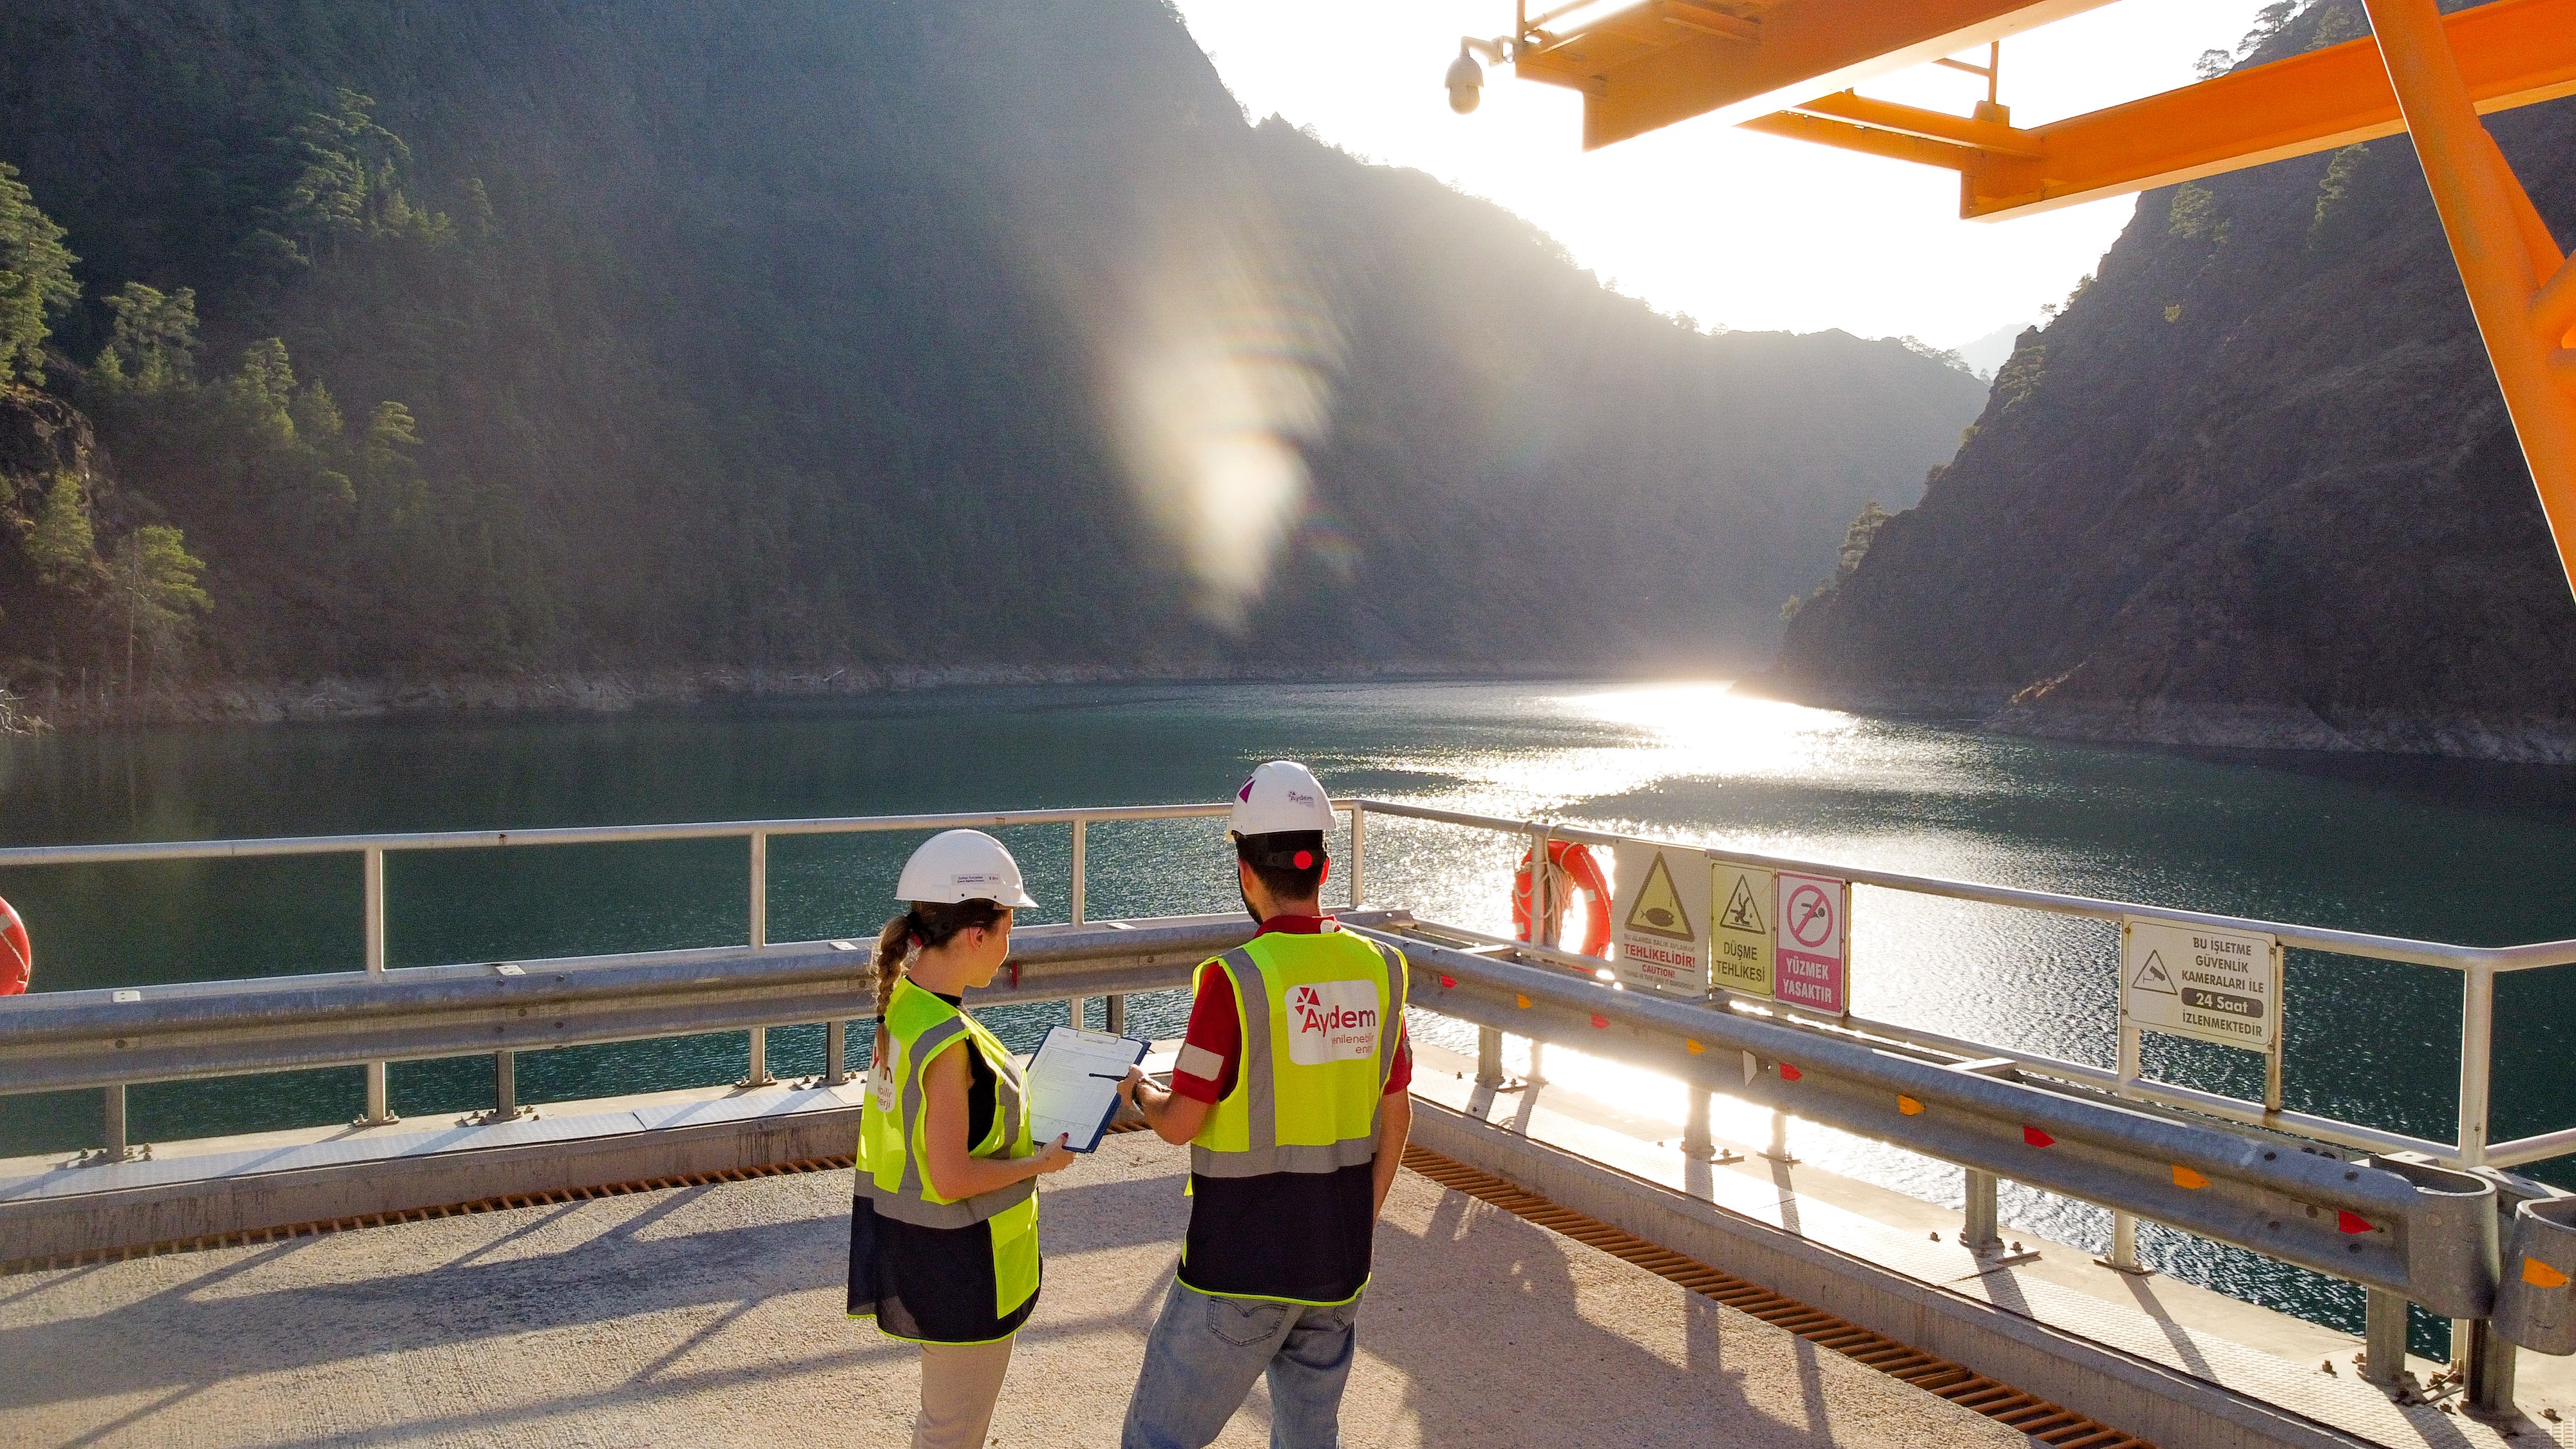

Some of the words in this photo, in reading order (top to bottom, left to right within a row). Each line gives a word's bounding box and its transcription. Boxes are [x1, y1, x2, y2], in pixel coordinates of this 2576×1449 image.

[1624, 943, 1695, 968] TEHLİKELİDİR!
[1724, 940, 1757, 960] DÜŞME
[2193, 937, 2207, 949] BU
[2211, 936, 2251, 956] İŞLETME
[1642, 964, 1676, 978] CAUTION!
[1716, 960, 1765, 982] TEHLİKESİ
[1786, 956, 1828, 980] YÜZMEK
[2195, 953, 2248, 973] GÜVENLİK
[1783, 979, 1832, 1003] YASAKTIR
[2182, 970, 2245, 990] KAMERALARI
[2249, 978, 2264, 993] İLE
[2196, 992, 2213, 1007] 24
[2217, 996, 2248, 1013] Saat
[1302, 1005, 1376, 1037] Aydem
[2183, 1009, 2262, 1037] İZLENMEKTEDİR
